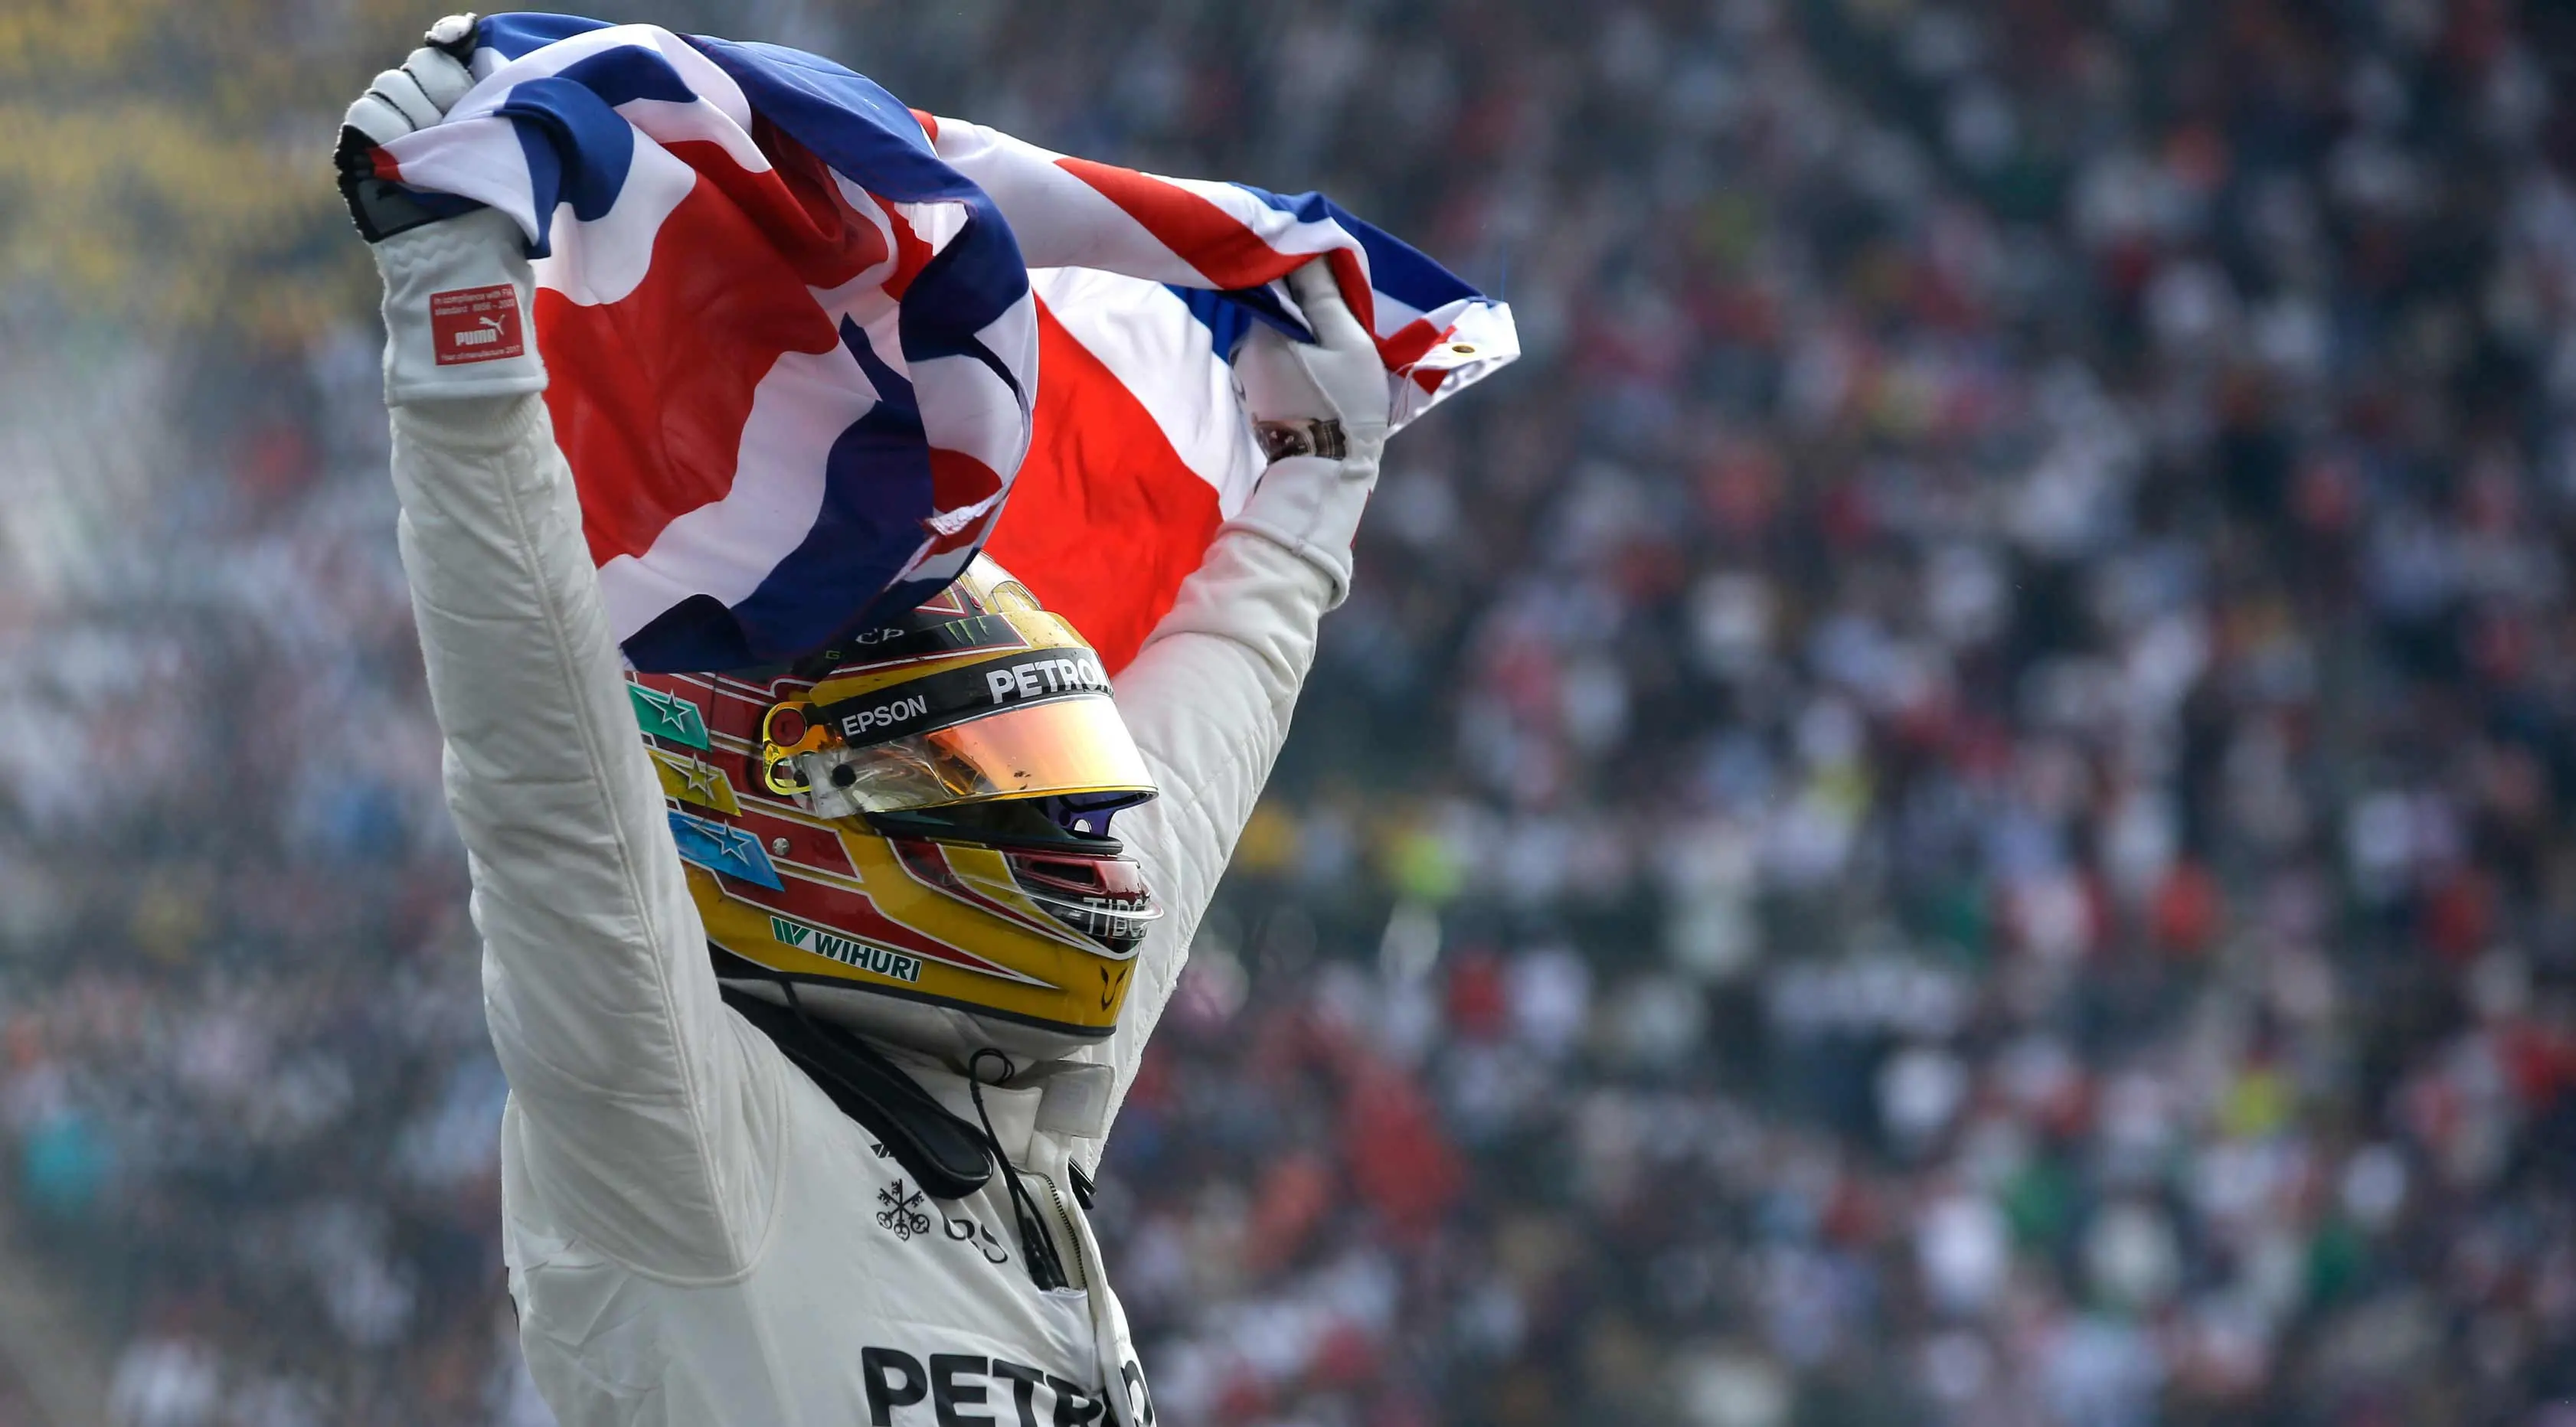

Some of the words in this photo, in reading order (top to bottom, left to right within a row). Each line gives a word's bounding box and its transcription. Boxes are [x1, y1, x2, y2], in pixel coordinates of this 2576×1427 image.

[455, 328, 497, 347] PUMA
[842, 694, 927, 736] EPSON
[815, 932, 920, 982] WIHURI
